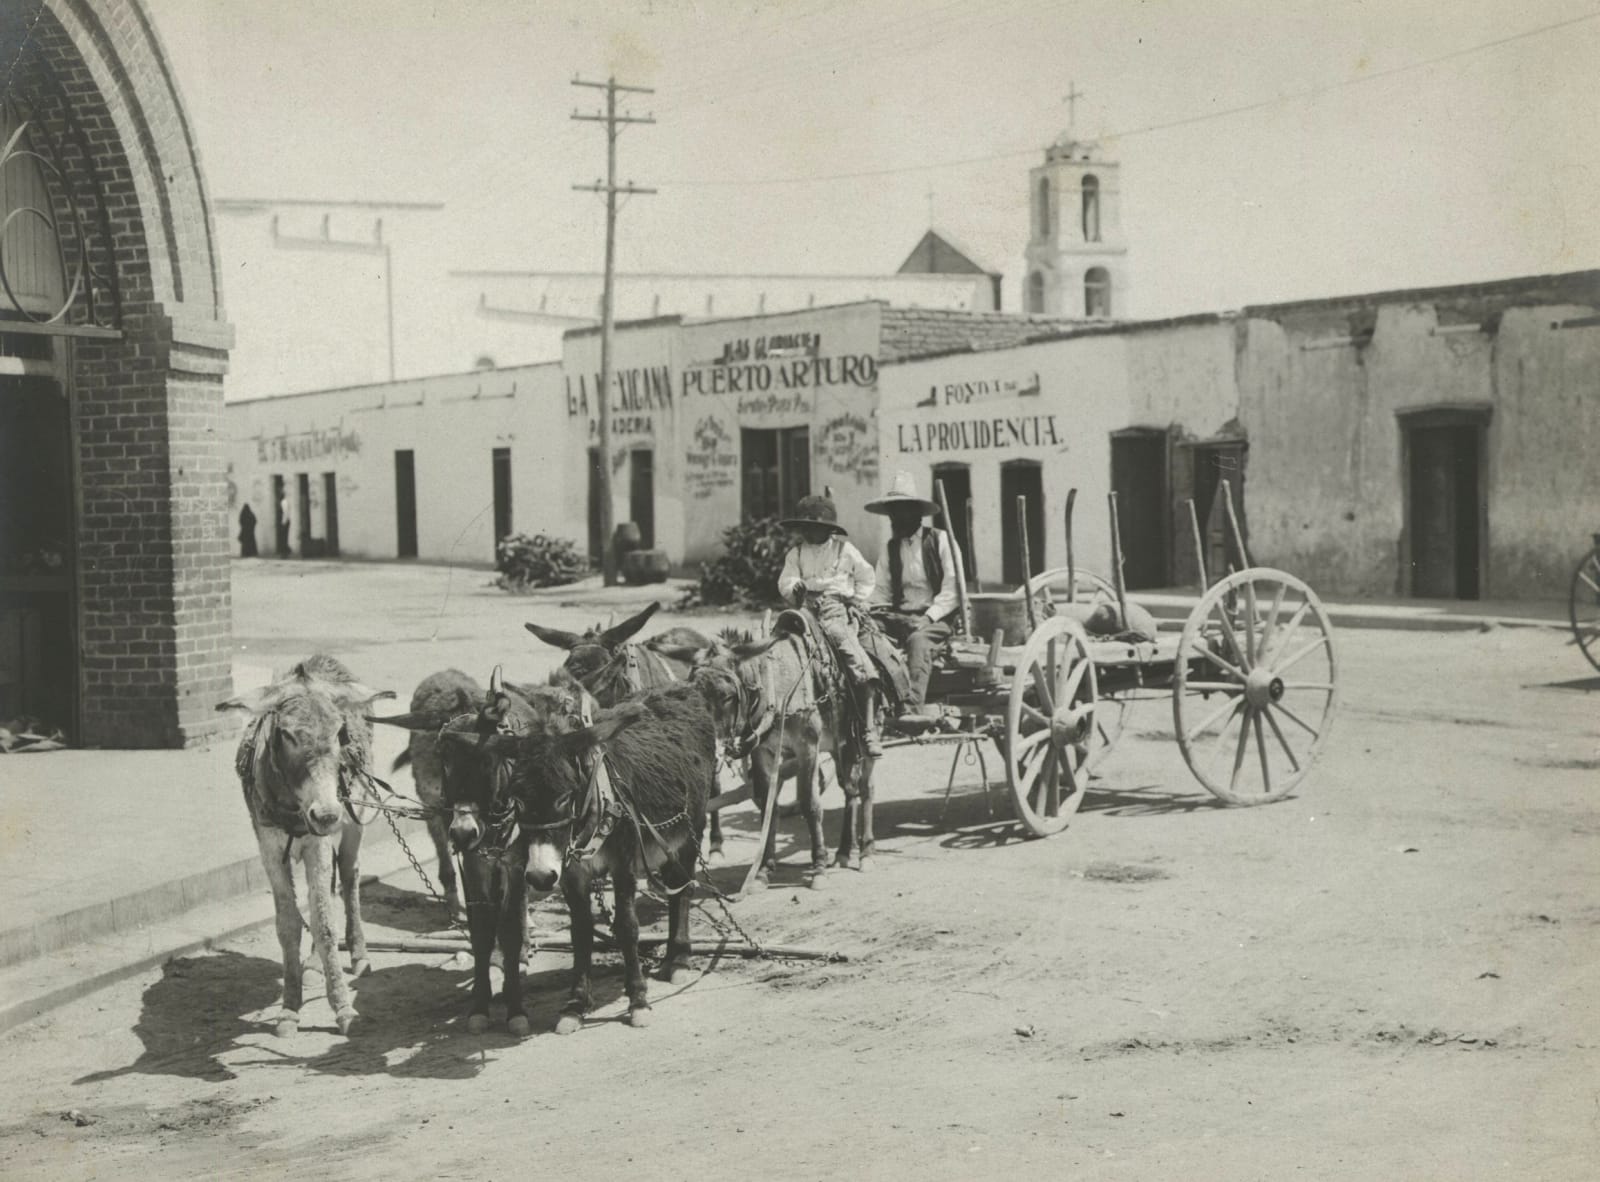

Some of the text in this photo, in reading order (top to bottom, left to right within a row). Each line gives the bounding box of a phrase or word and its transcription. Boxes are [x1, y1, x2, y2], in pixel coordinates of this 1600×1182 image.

[681, 353, 878, 398] PUERTO ARTURO
[588, 417, 653, 439] PADERIA
[898, 424, 923, 452] LA
